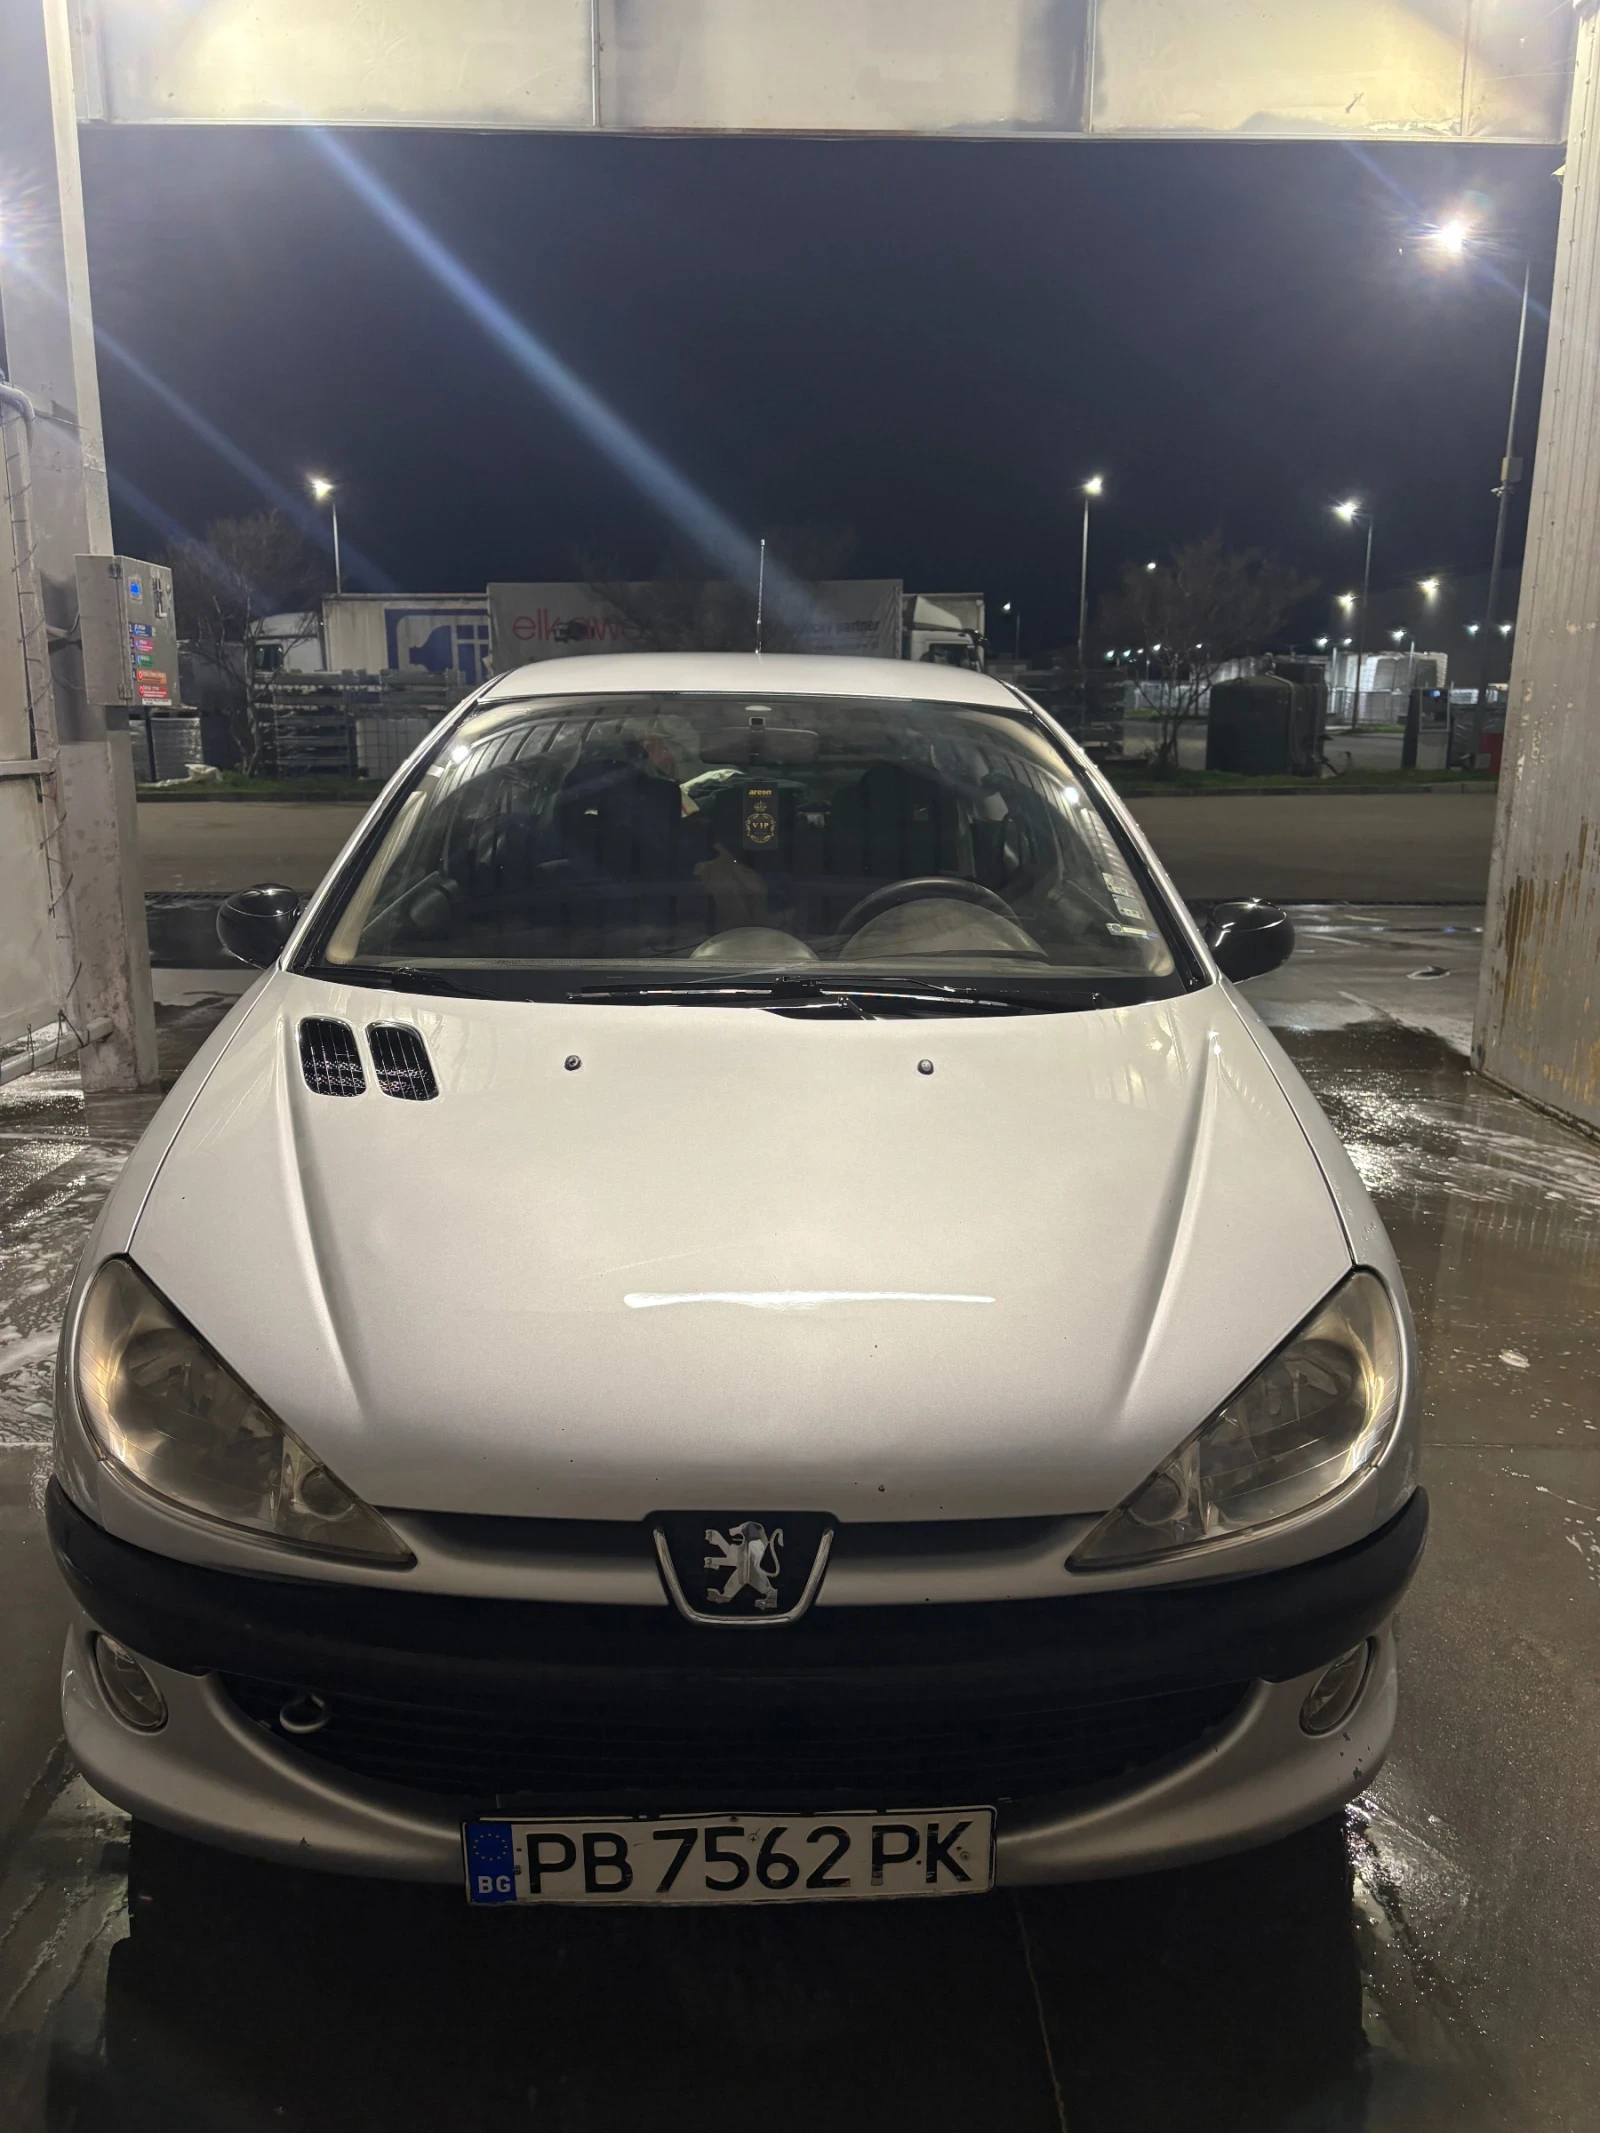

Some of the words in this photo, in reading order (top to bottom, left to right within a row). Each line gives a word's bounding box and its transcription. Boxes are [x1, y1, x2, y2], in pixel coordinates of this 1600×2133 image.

[525, 1831, 634, 1894] PB
[652, 1825, 851, 1894] 7562
[870, 1820, 974, 1887] PK
[477, 1874, 512, 1894] BG
